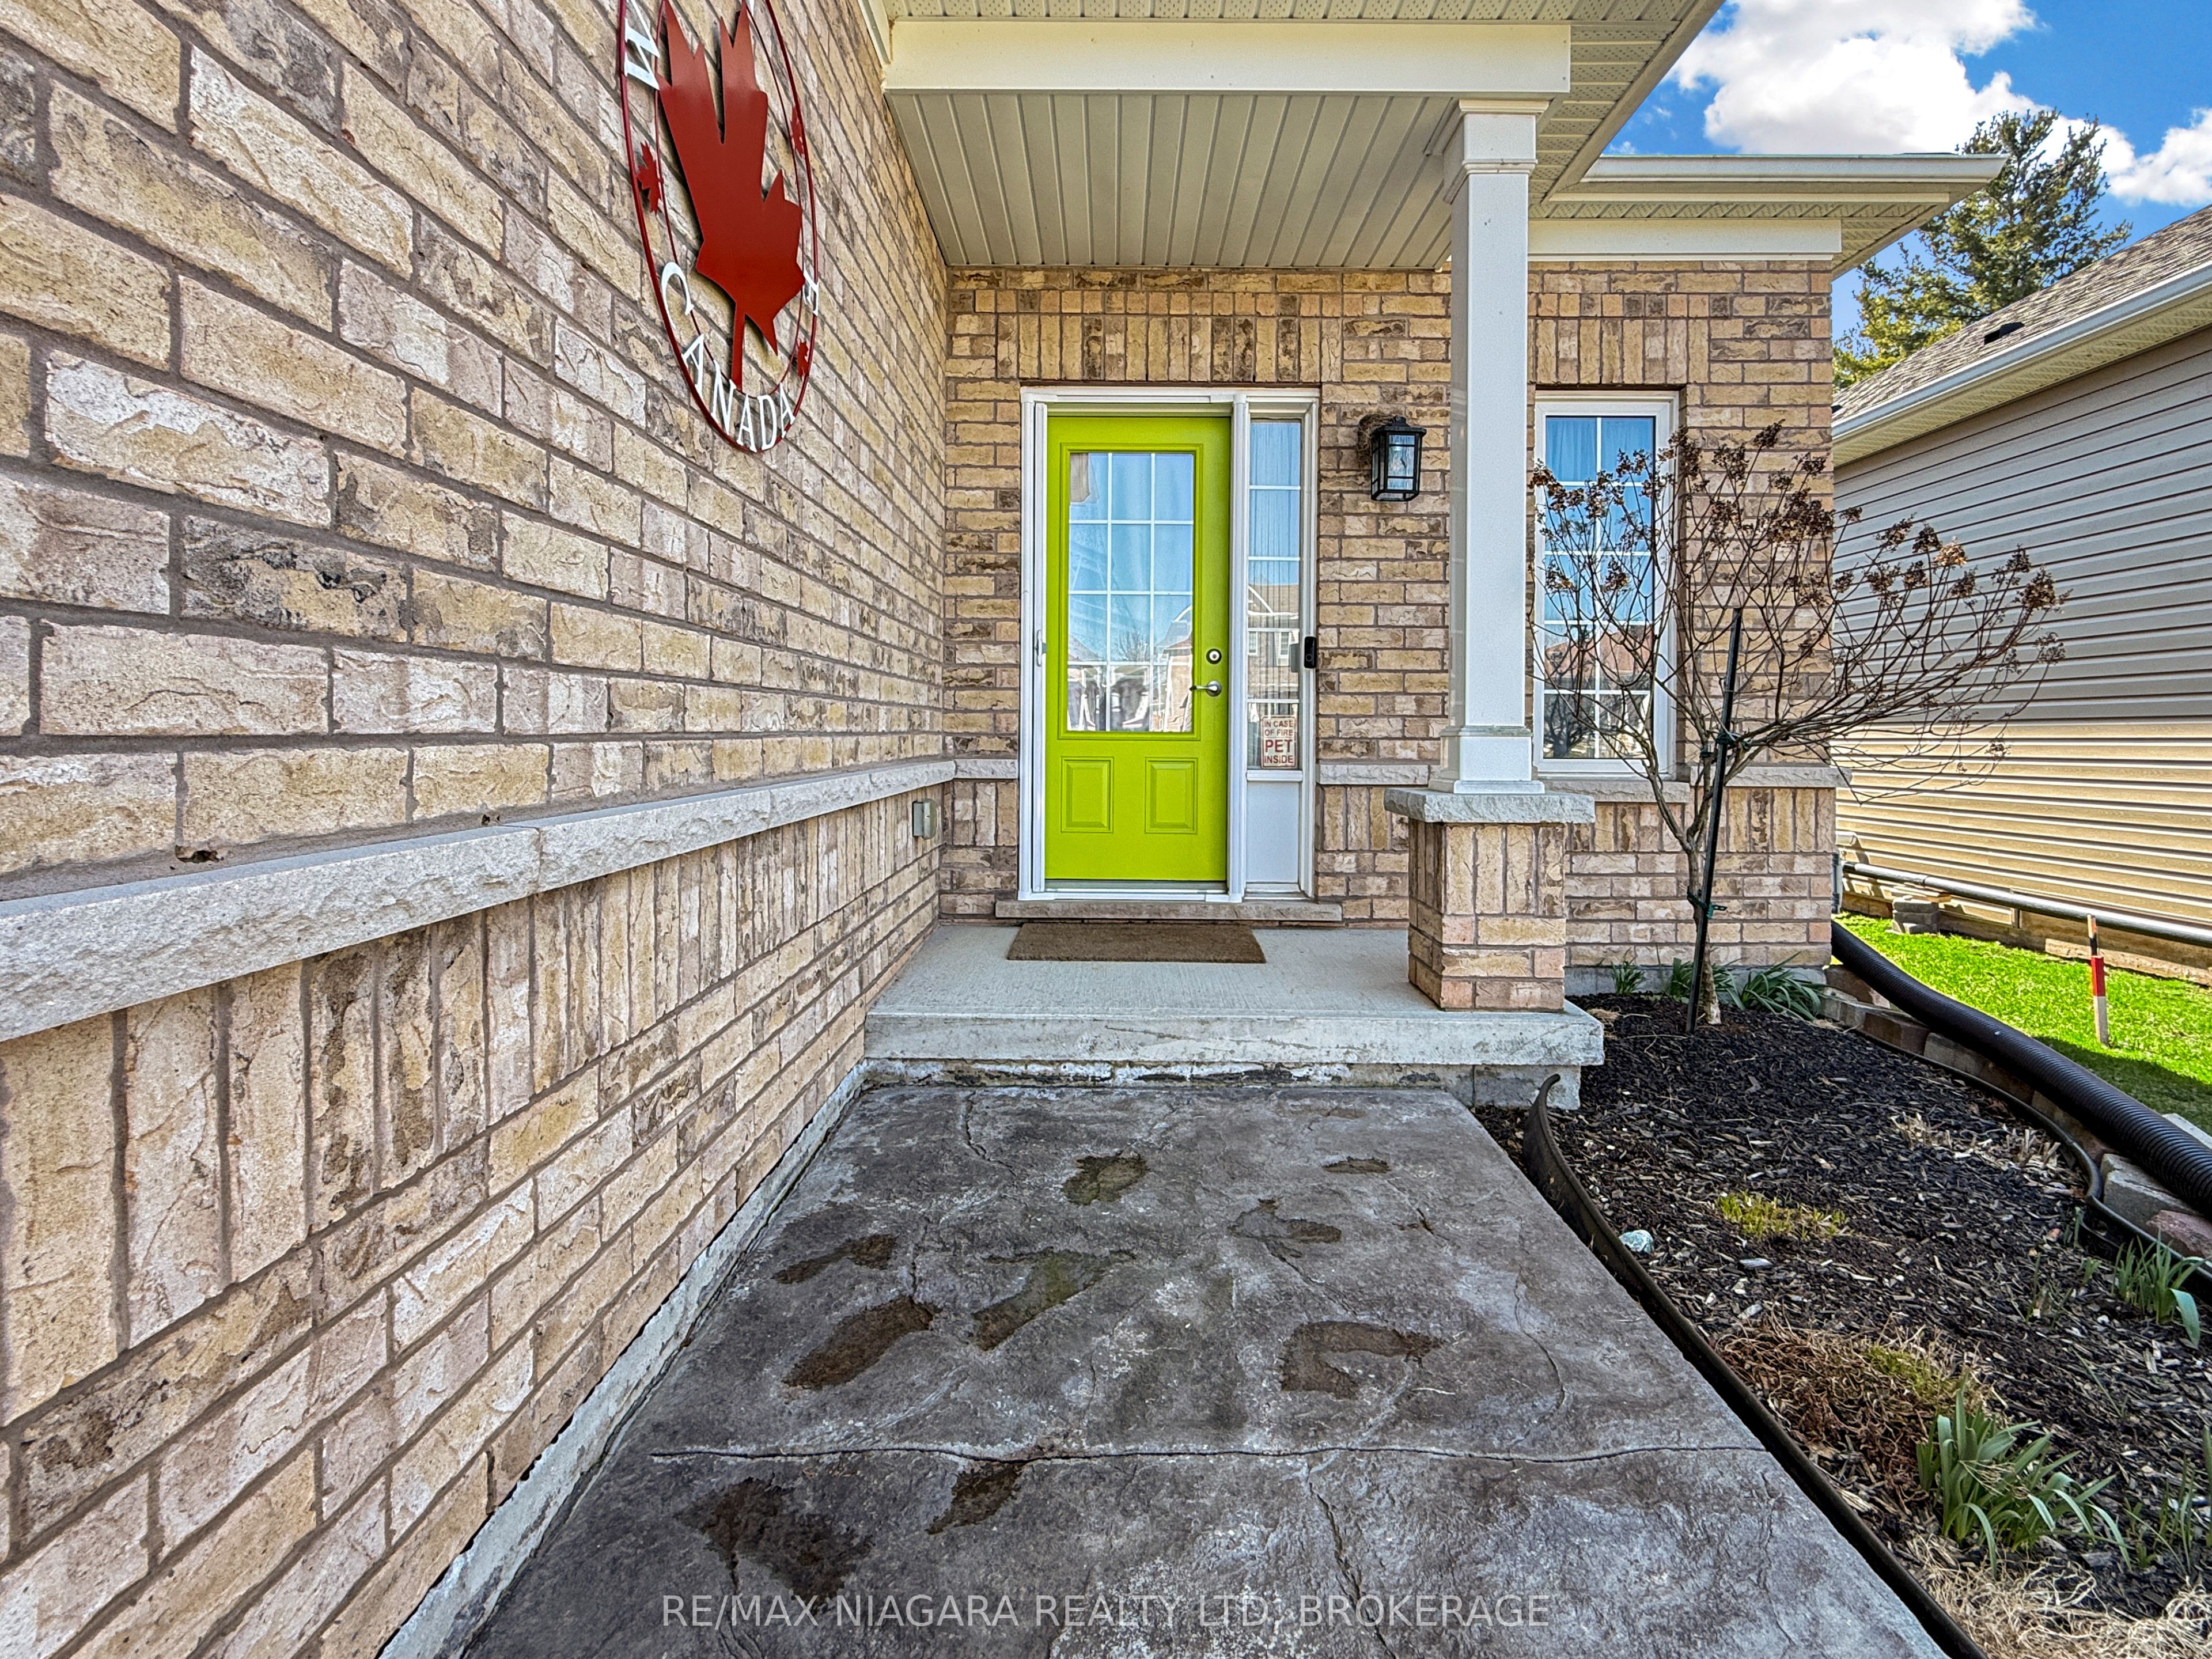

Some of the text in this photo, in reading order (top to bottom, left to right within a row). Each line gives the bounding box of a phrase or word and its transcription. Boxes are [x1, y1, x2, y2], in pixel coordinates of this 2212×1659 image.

[662, 262, 796, 452] CANADA
[1265, 739, 1293, 752] PET
[1264, 755, 1293, 763] INSIDE
